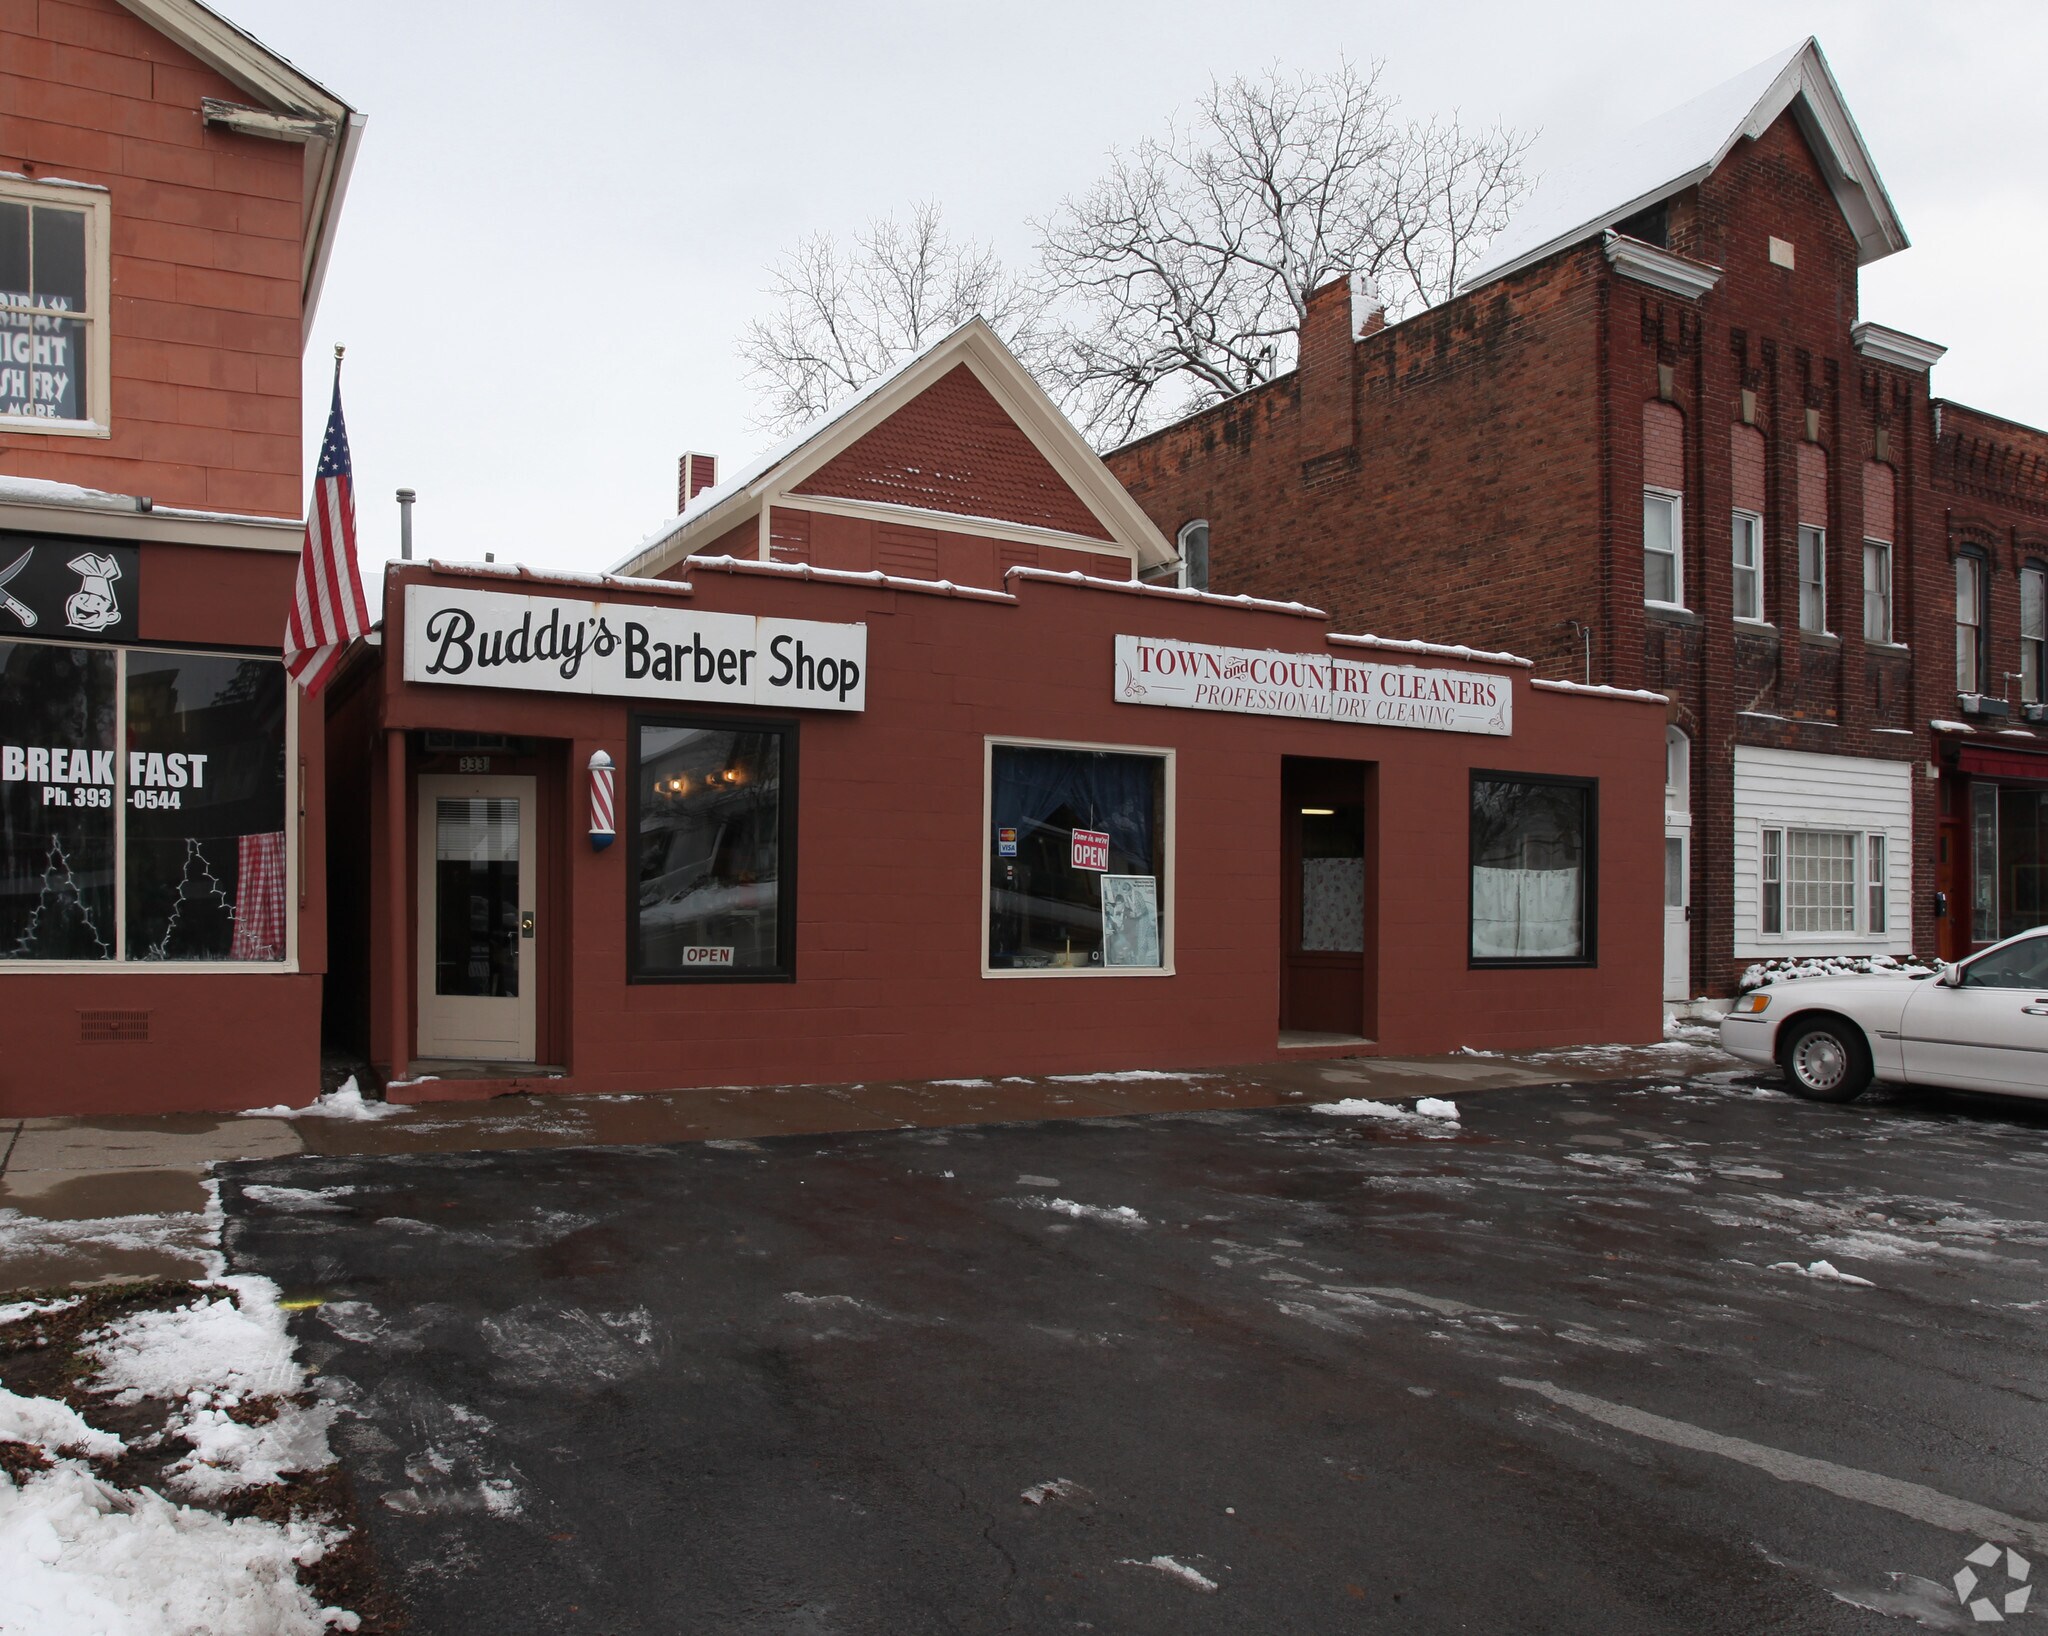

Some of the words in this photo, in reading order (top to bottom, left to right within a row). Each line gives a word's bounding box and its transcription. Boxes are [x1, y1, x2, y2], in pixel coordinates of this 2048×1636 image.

[0, 331, 67, 367] IGHT
[33, 371, 69, 403] FRY
[425, 607, 622, 680] Buddy's
[625, 621, 757, 686] Barber
[768, 634, 860, 703] Shop
[1136, 645, 1222, 680] TOWN
[1224, 657, 1249, 680] and
[1250, 658, 1372, 695] COUNTRY
[1380, 672, 1497, 708] CLEANERS
[1195, 683, 1329, 715] PROFESSIONAL
[1336, 696, 1371, 718] DRY
[1376, 700, 1455, 726] CLEANING
[461, 758, 485, 770] 333
[43, 786, 72, 807] Ph.
[1074, 844, 1106, 867] OPEN
[687, 948, 730, 962] OPEN
